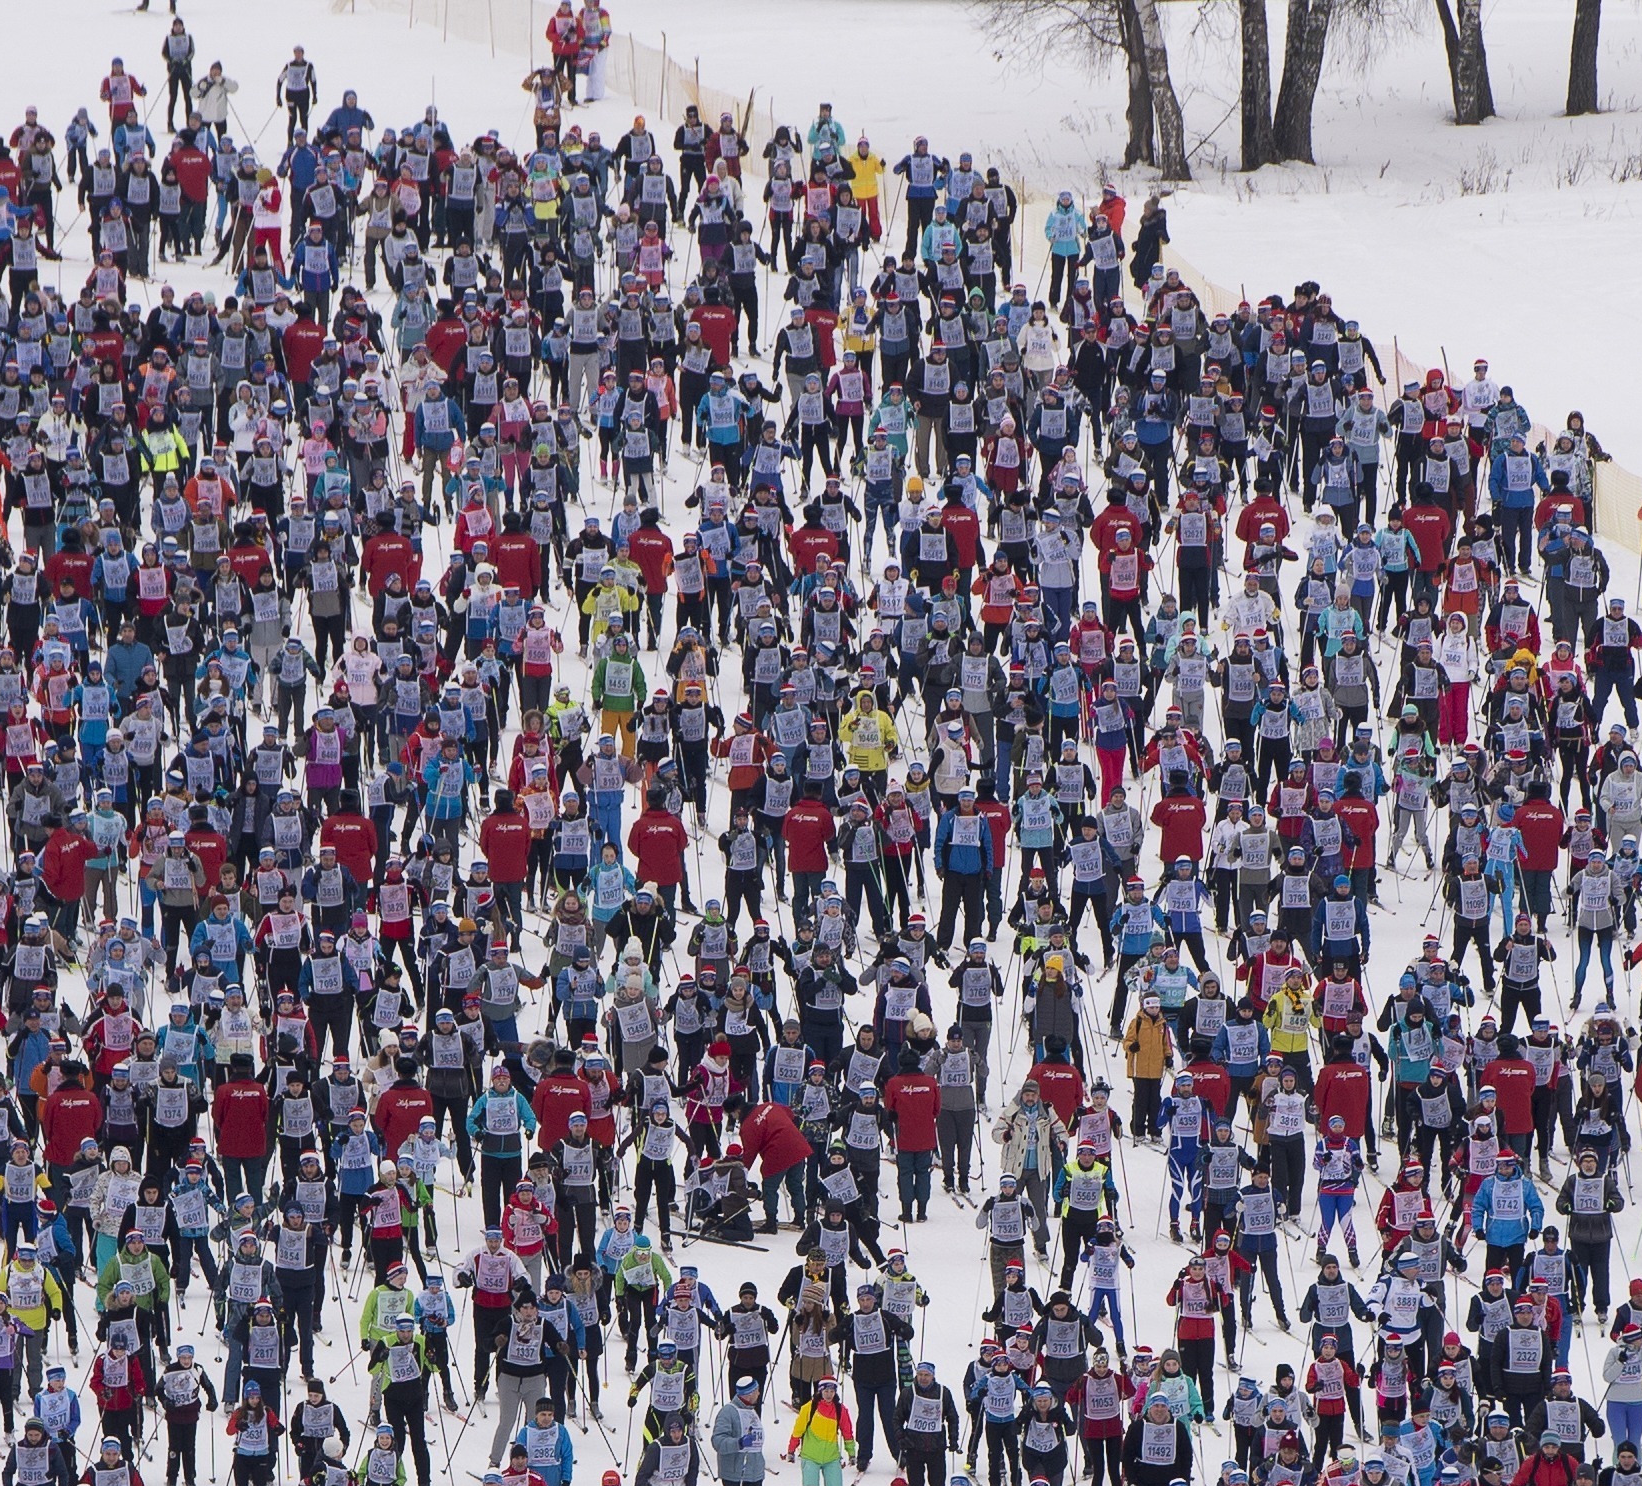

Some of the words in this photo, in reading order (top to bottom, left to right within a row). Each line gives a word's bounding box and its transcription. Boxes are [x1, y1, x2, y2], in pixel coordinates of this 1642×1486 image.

[1475, 1159, 1494, 1169] 7003
[1497, 1200, 1518, 1209] 6742
[1250, 1216, 1270, 1225] 8536
[998, 1224, 1018, 1233] 7326
[1094, 1267, 1112, 1276] 5566
[19, 1295, 38, 1304] 7174
[860, 1333, 879, 1344] 3702
[1052, 1343, 1071, 1353] 3761
[1517, 1352, 1537, 1361] 2322
